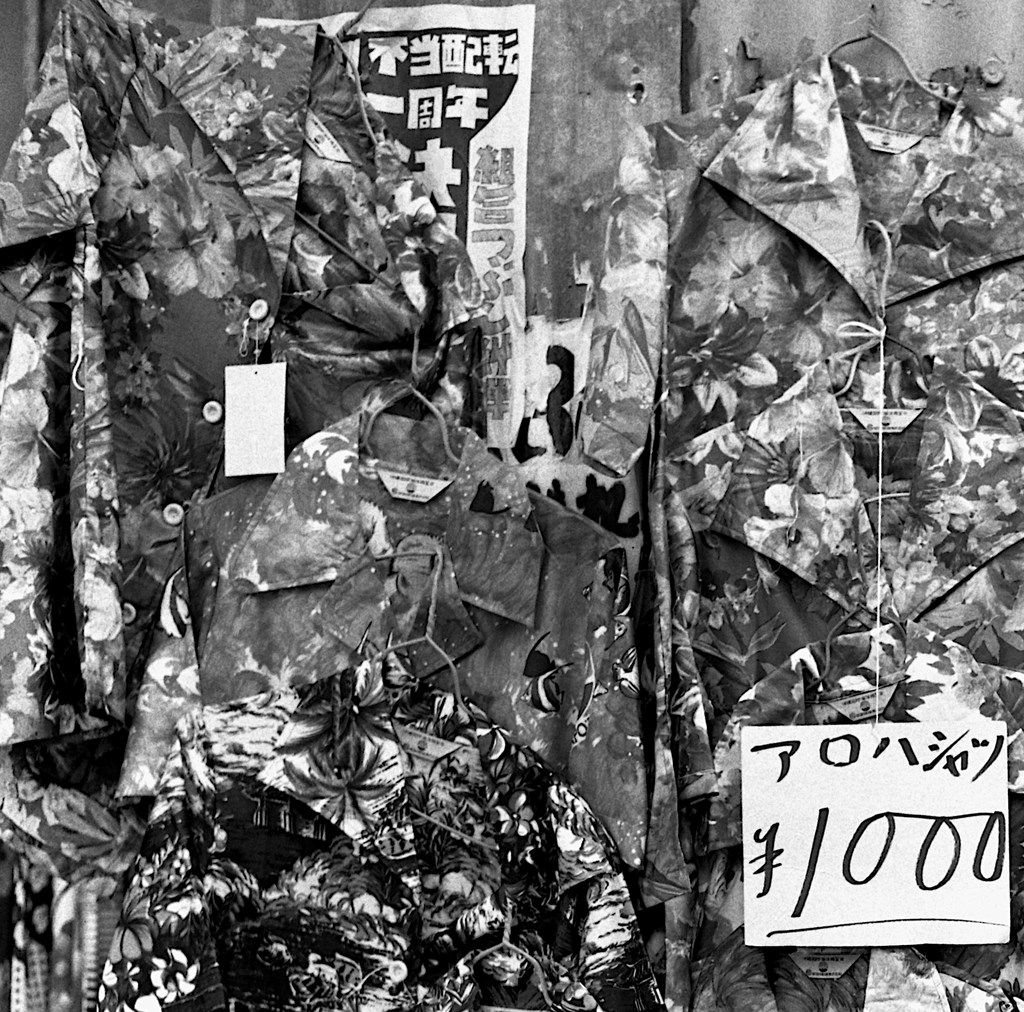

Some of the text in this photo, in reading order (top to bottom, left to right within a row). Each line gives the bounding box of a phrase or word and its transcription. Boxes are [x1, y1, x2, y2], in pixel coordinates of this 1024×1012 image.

[750, 729, 1005, 783] アロハシャツ
